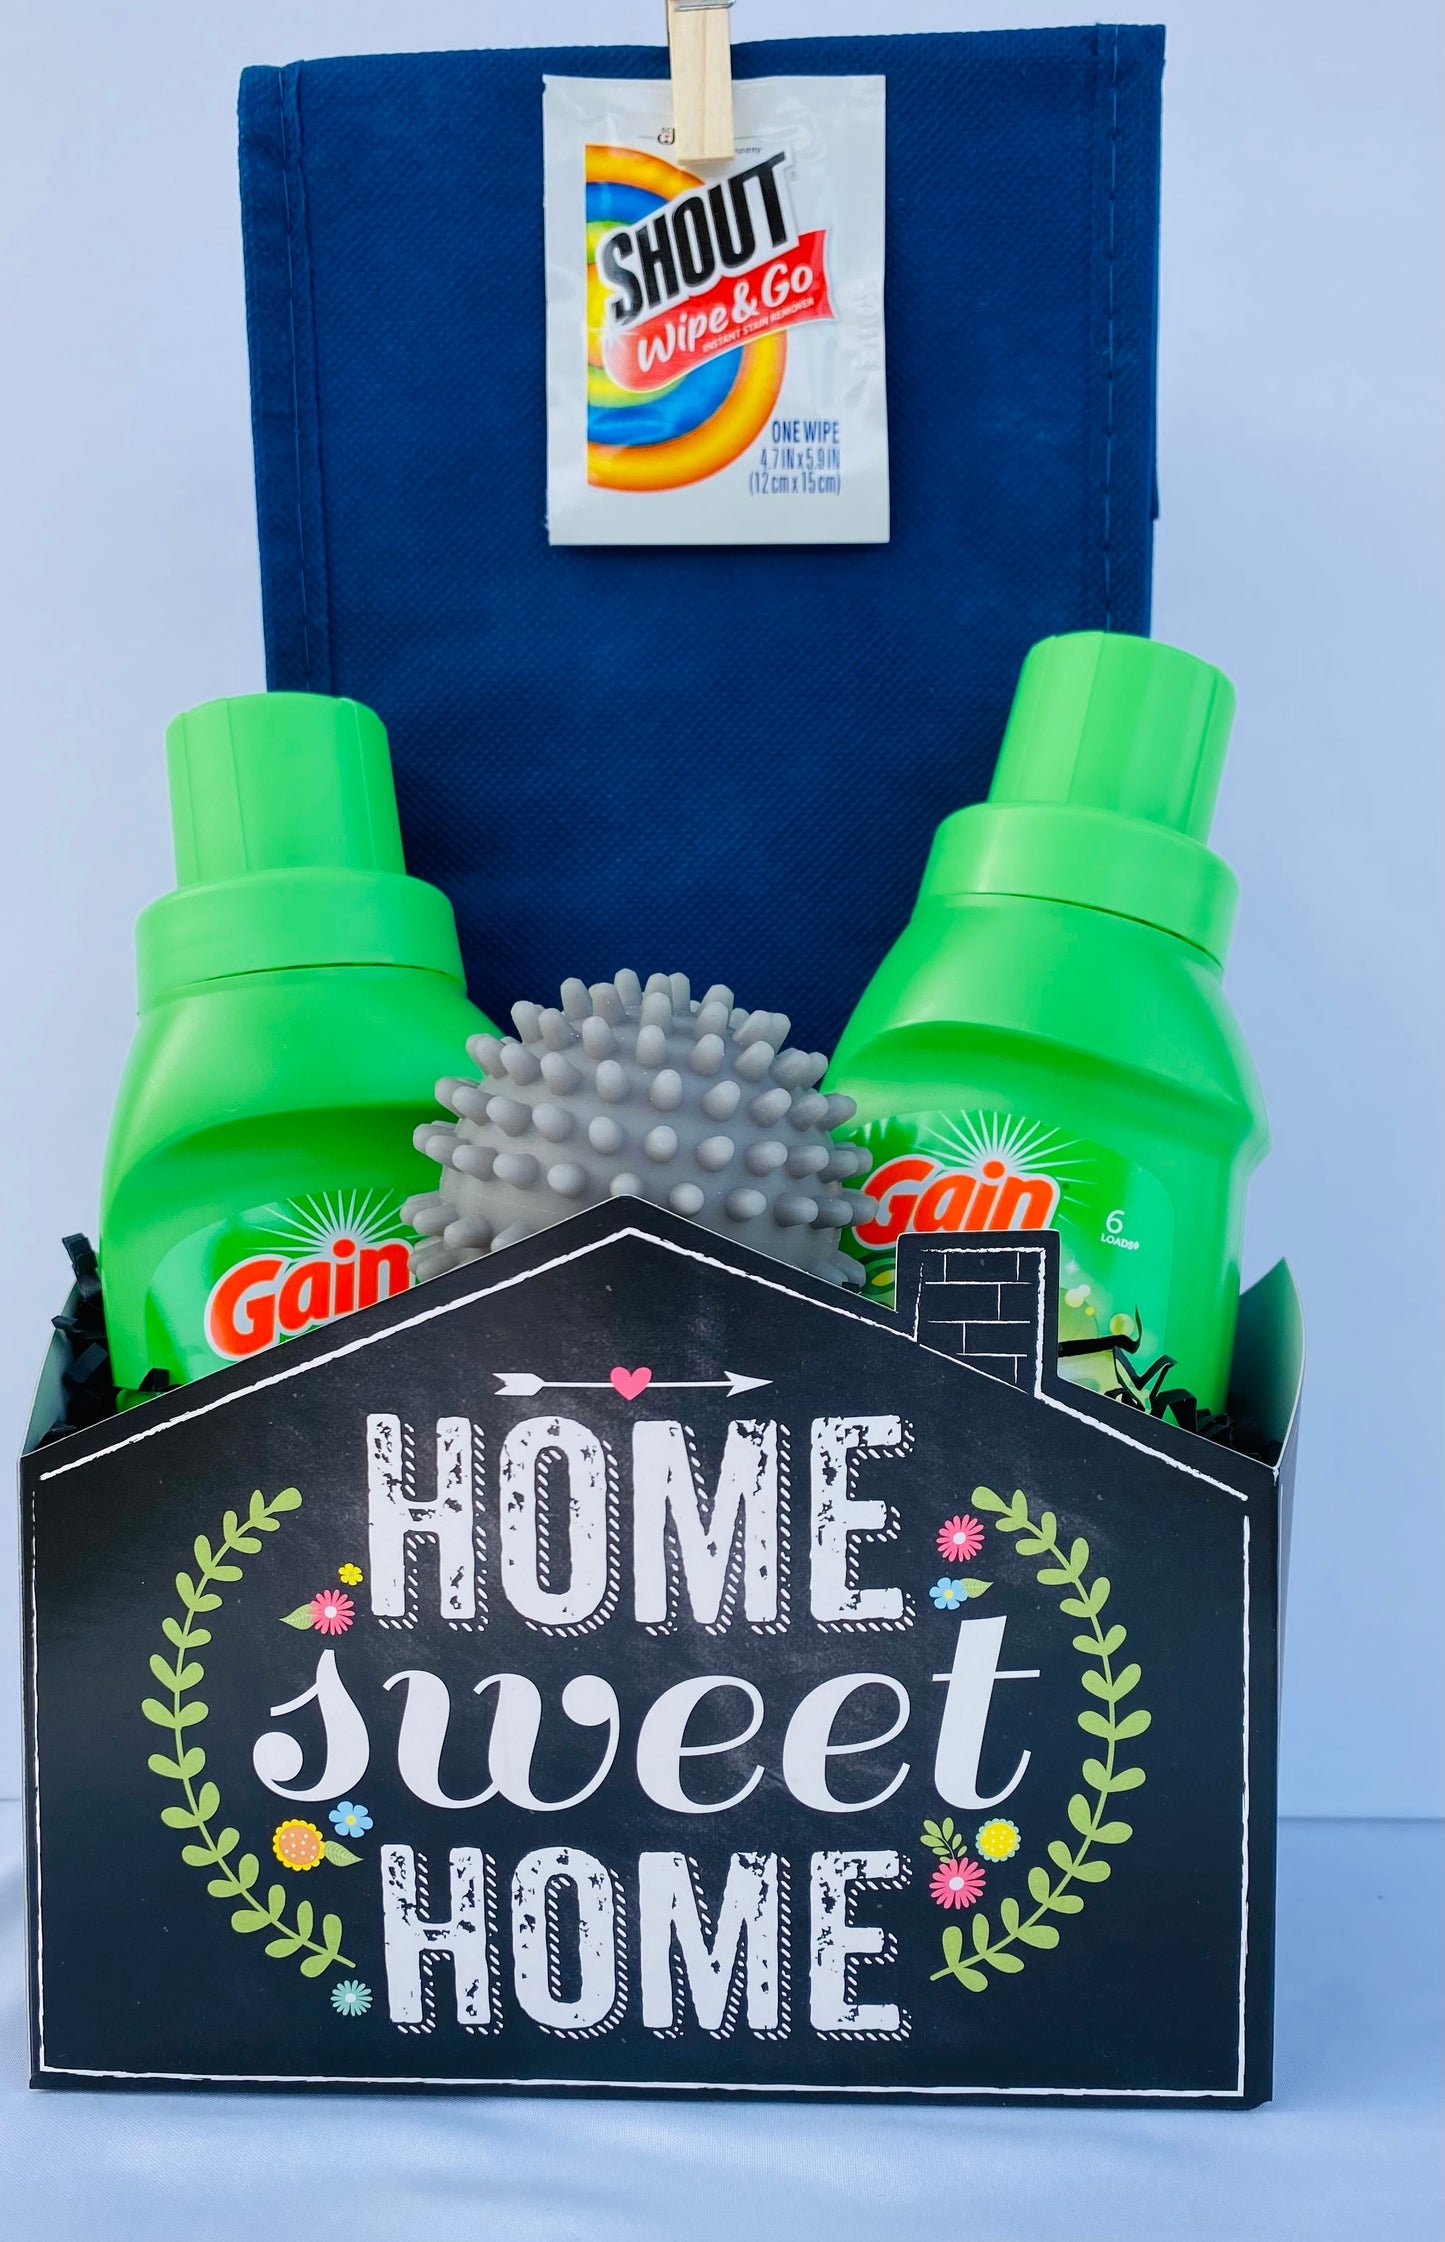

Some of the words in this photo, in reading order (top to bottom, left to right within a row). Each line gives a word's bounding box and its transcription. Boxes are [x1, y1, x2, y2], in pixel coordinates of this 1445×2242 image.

[602, 151, 787, 325] SHOUT
[702, 328, 742, 353] INSTANT
[742, 316, 769, 335] STAIN
[769, 297, 815, 322] REMOVER
[772, 420, 800, 444] ONE
[803, 420, 840, 444] WIPE
[854, 1158, 1056, 1246] Gain
[1106, 1209, 1126, 1235] 6
[208, 1237, 412, 1357] Gain
[366, 1412, 914, 1636] HOME
[252, 1615, 1041, 1814] sweet
[380, 1843, 912, 2040] HOME
